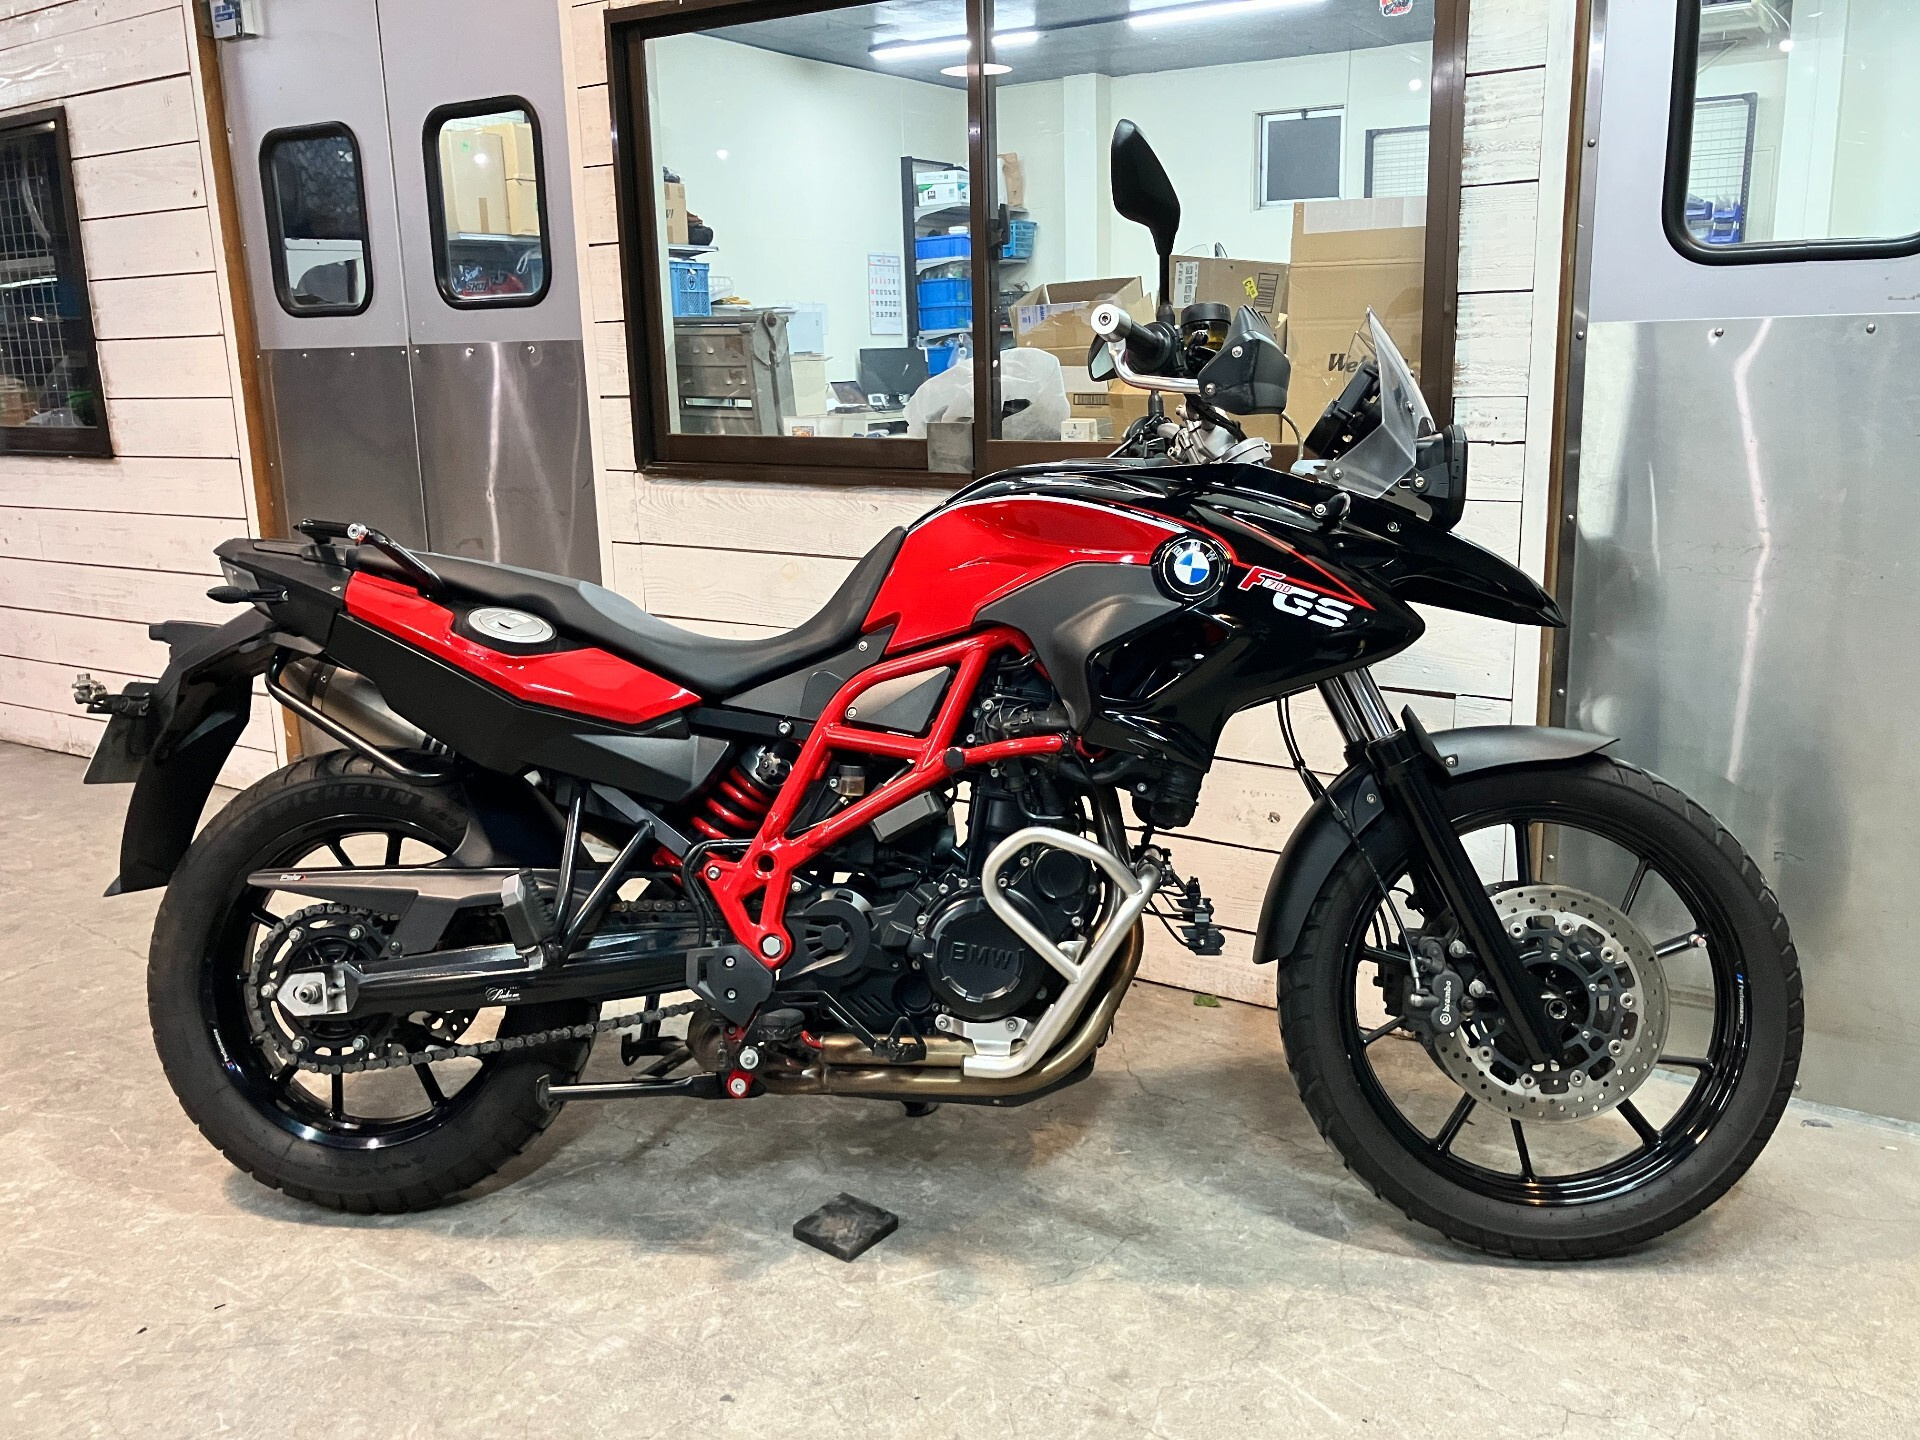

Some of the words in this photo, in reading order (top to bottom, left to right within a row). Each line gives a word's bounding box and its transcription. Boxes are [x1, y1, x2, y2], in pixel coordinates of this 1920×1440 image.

[1171, 541, 1218, 562] BMW
[1237, 566, 1287, 591] F
[1267, 580, 1292, 594] 700
[1272, 583, 1354, 628] GS
[268, 783, 413, 818] MICHELIN
[951, 941, 1013, 969] BMW
[1442, 980, 1451, 1012] brembo
